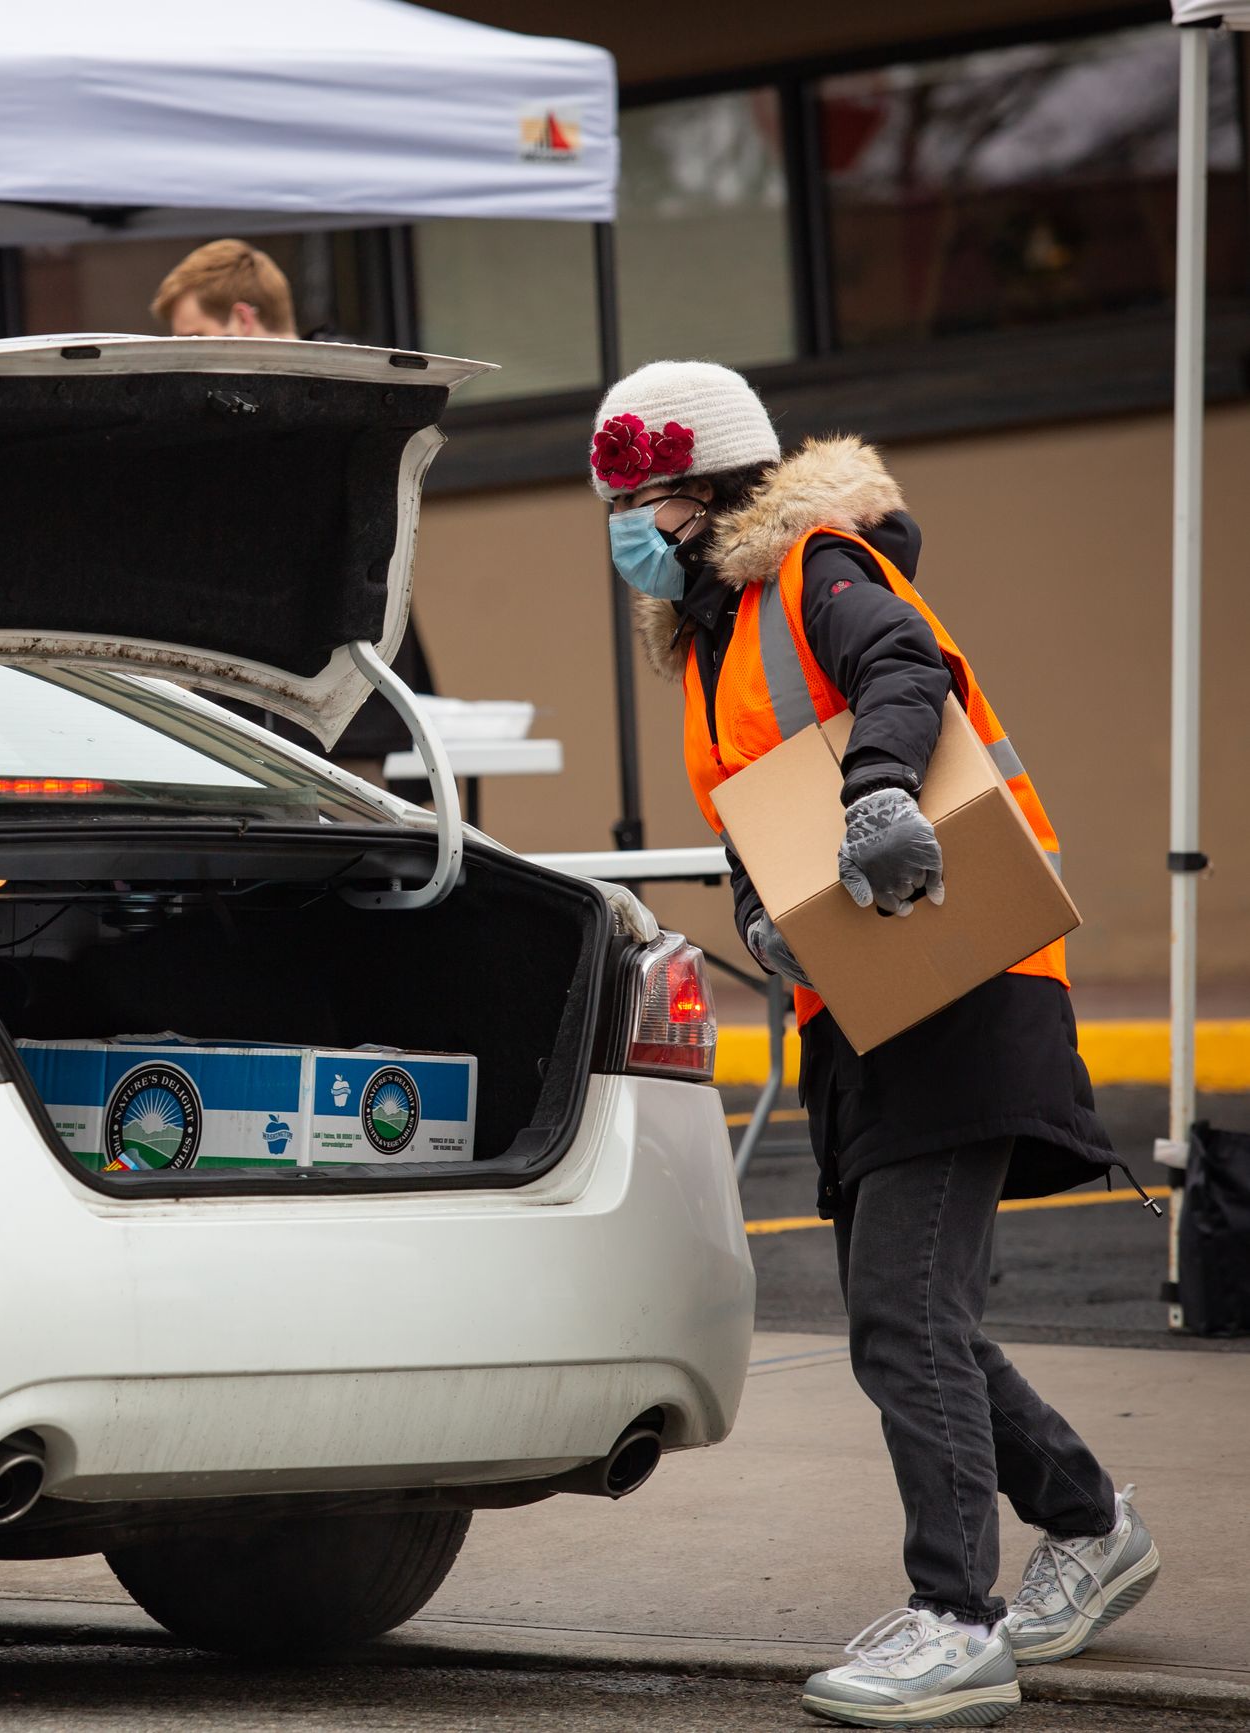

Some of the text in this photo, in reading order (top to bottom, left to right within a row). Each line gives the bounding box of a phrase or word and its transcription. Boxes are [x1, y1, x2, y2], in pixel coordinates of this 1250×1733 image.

[115, 1074, 194, 1122] NATURE'S DELIGHT
[367, 1074, 415, 1106] NATURE'S DELIGHT
